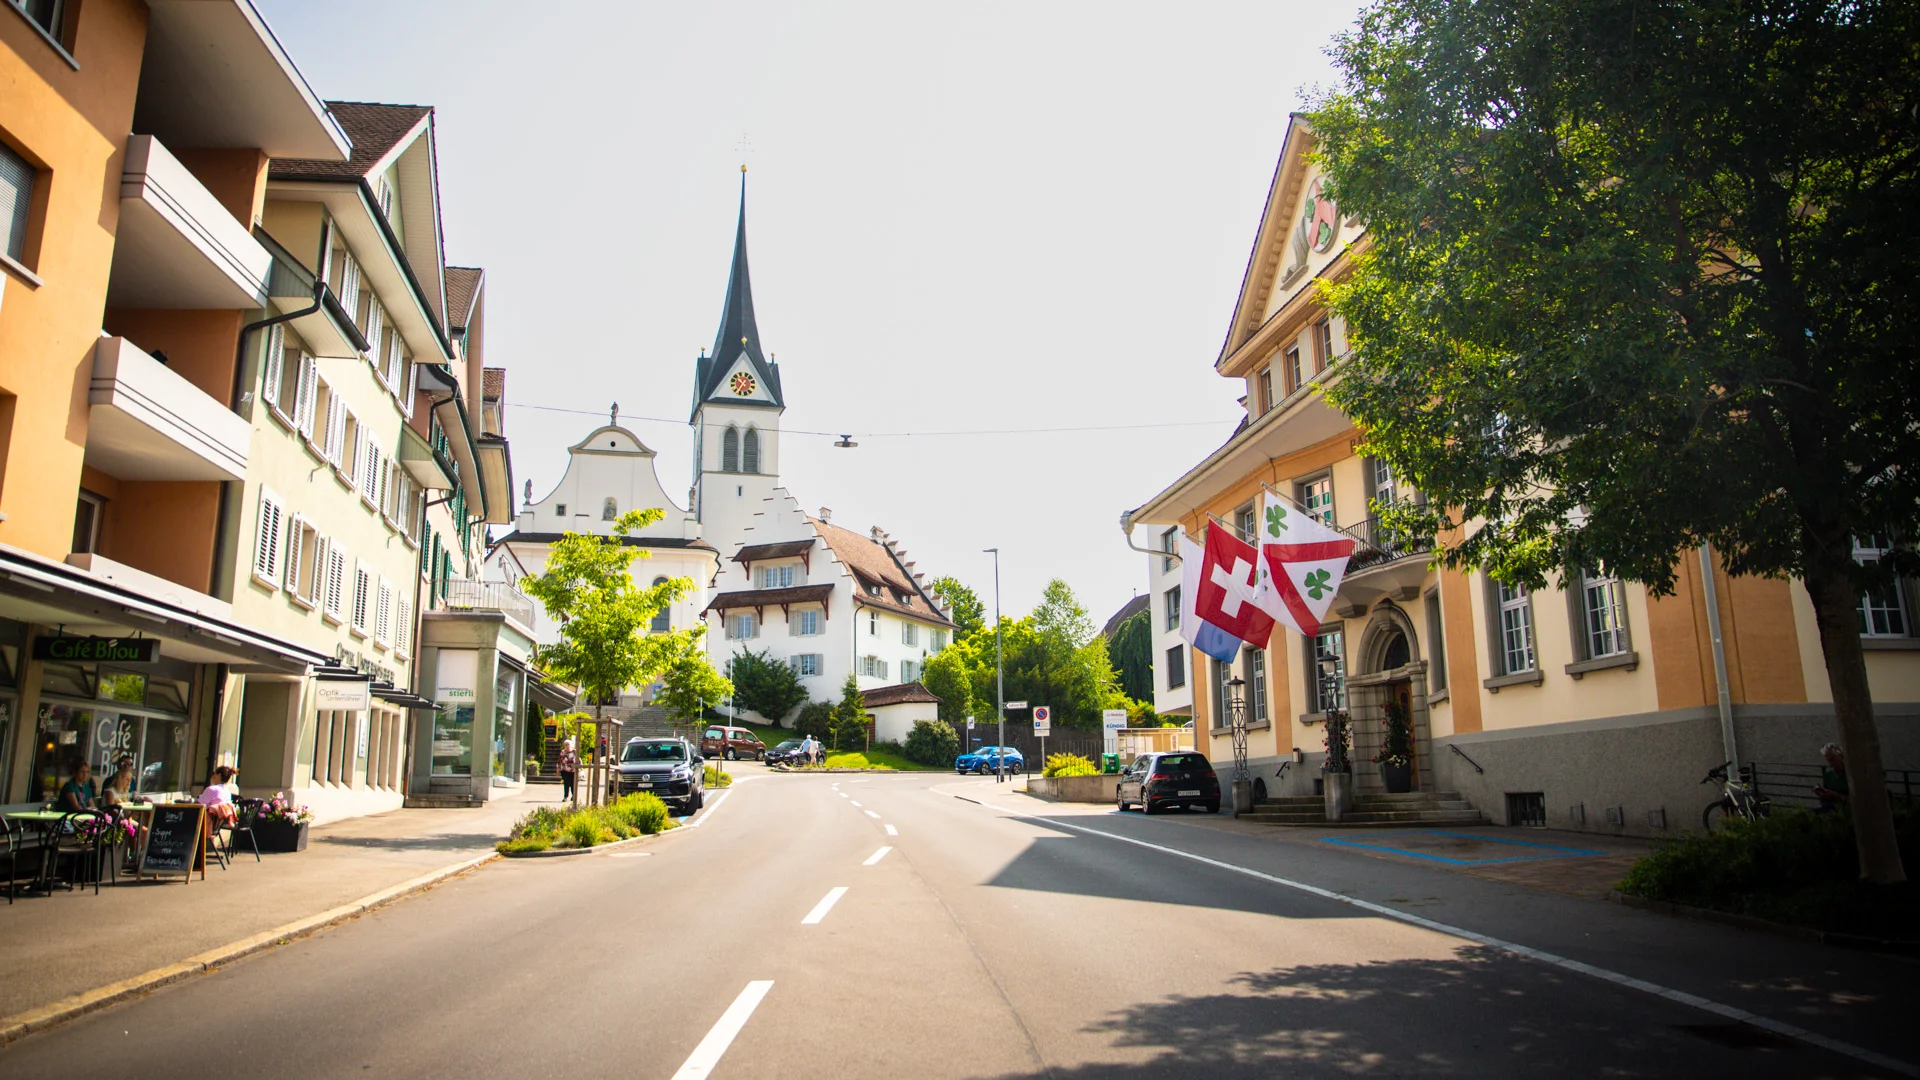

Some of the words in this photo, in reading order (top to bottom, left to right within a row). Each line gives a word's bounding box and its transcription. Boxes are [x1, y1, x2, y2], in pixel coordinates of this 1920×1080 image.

[49, 639, 92, 659] Café
[95, 639, 139, 660] Bijou
[318, 688, 340, 697] Optik
[448, 689, 474, 697] stierli
[97, 718, 132, 749] Café
